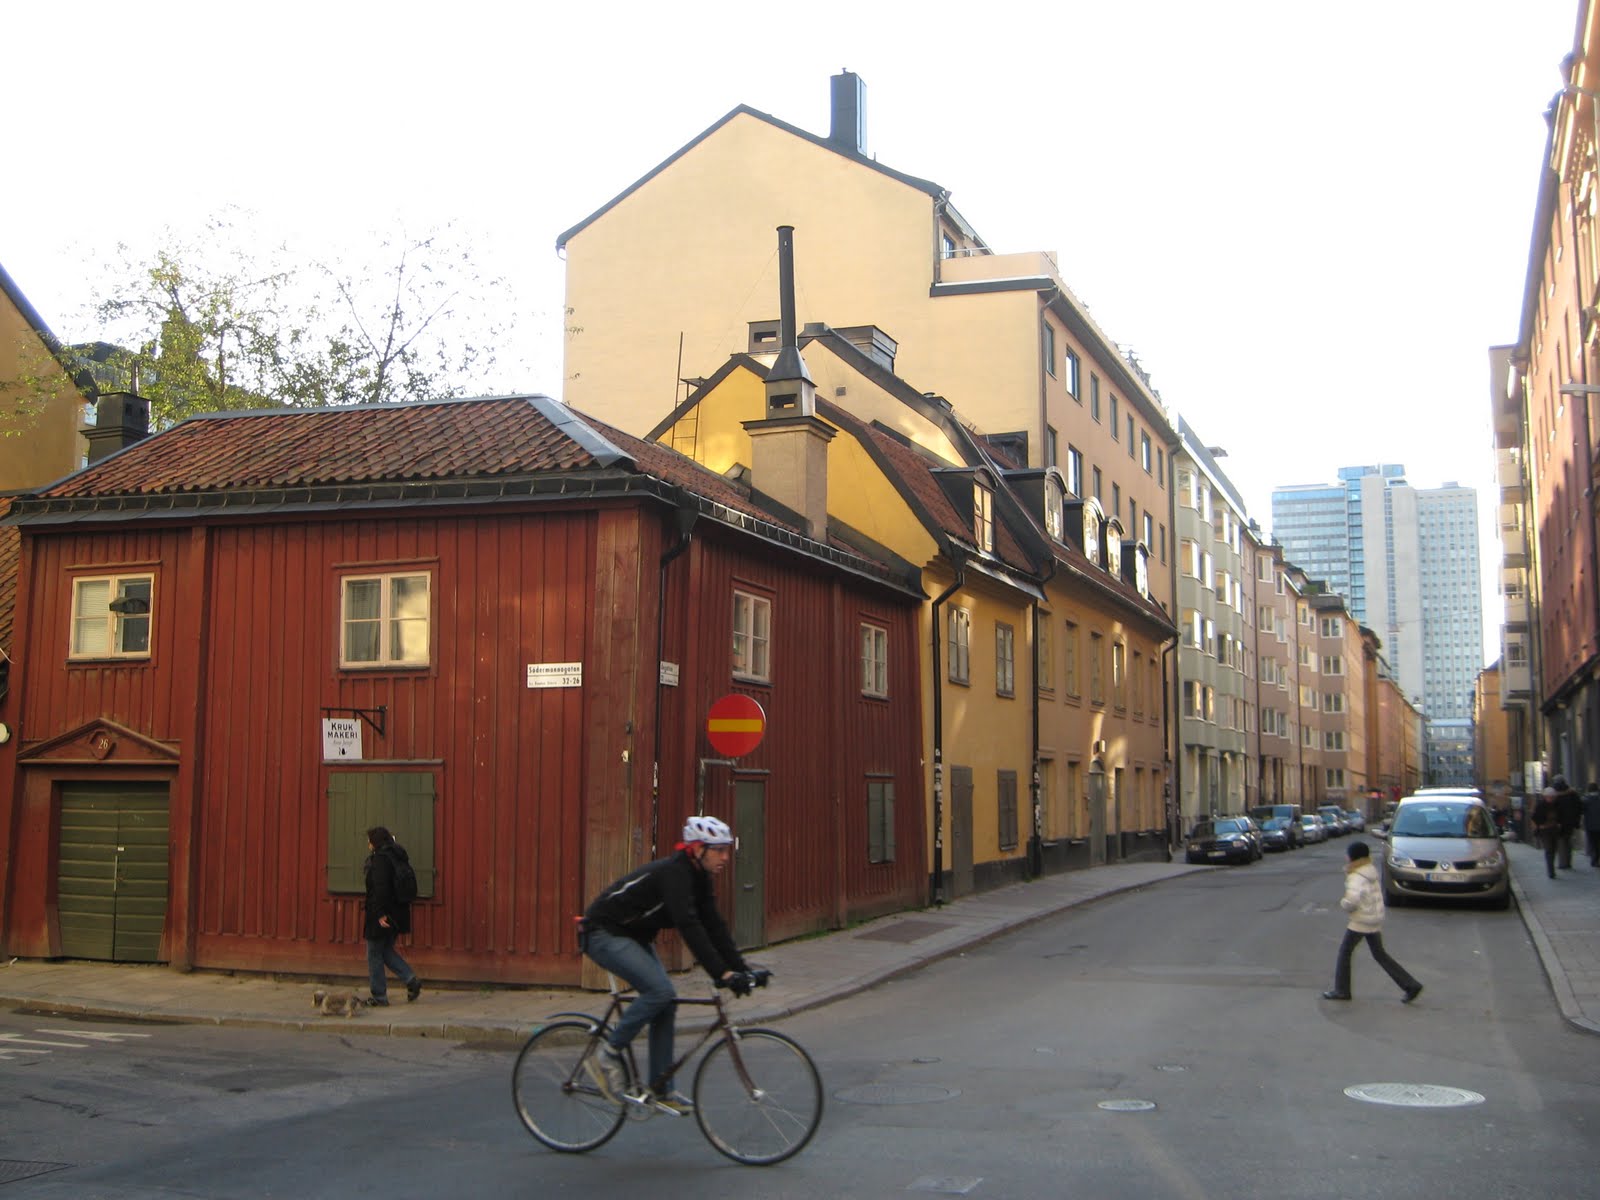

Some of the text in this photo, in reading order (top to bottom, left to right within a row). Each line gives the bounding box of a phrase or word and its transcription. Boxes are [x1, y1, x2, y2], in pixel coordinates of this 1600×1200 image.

[562, 677, 580, 685] 32-26
[331, 722, 354, 731] KRUK
[327, 731, 358, 739] MAKERI
[98, 739, 109, 749] 26
